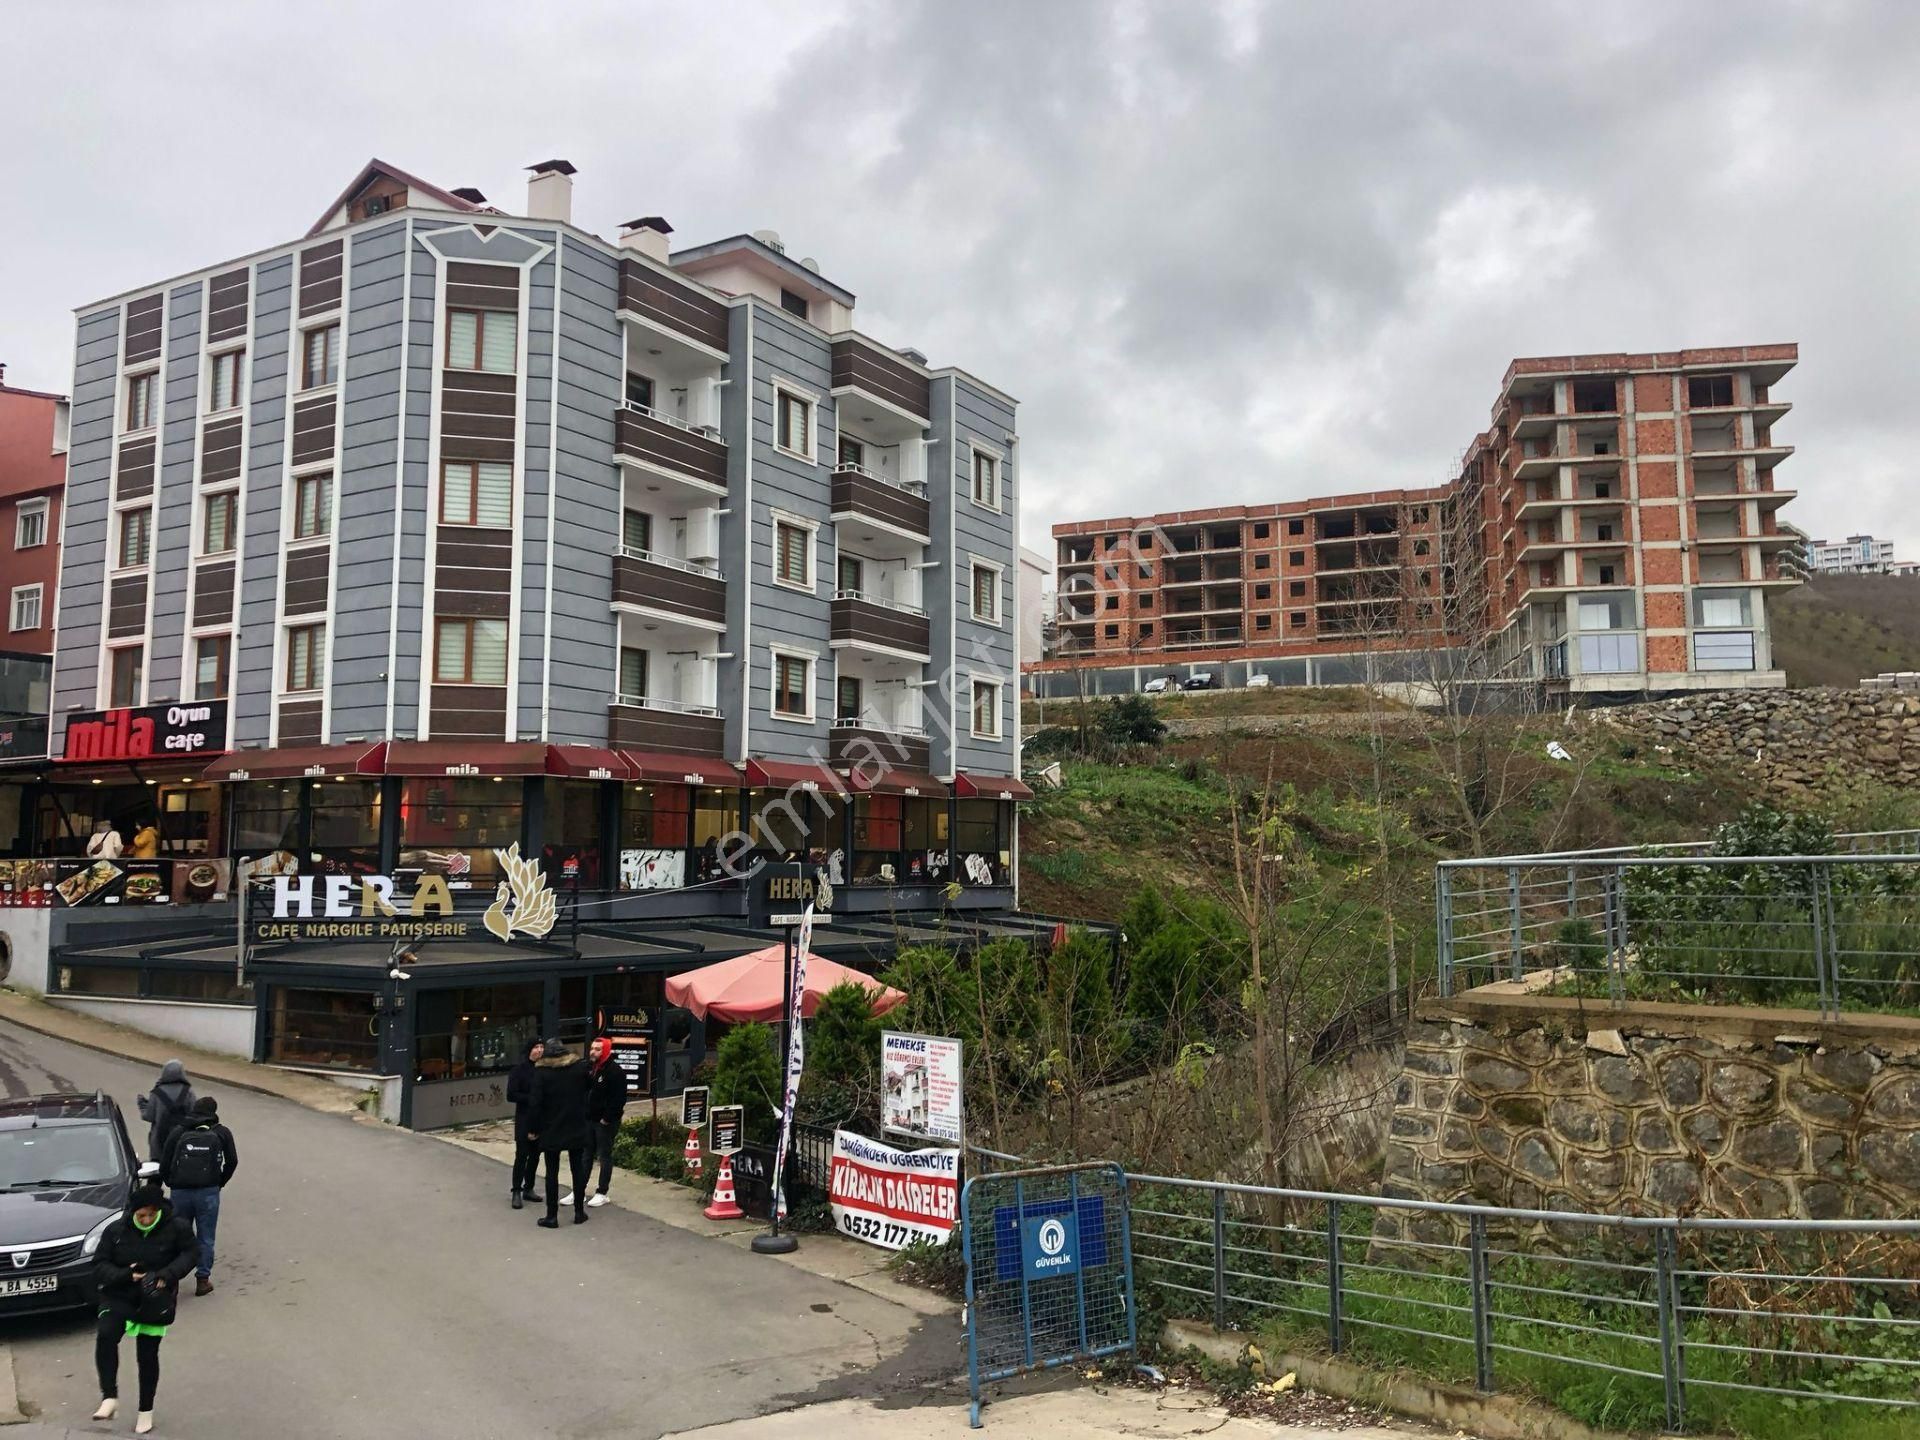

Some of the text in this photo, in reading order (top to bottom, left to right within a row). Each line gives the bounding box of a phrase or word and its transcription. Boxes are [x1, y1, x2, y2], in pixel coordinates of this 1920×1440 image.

[167, 707, 210, 727] Oyun
[67, 709, 156, 759] mila
[165, 732, 204, 751] cafe
[229, 769, 249, 780] mila
[304, 765, 326, 776] mila
[446, 764, 480, 775] mila
[589, 767, 612, 778] mila
[684, 772, 704, 784] mila
[272, 875, 454, 918] HERA
[769, 878, 814, 899] HERA
[258, 922, 467, 938] CAFE NARGILE PATISSERIE
[450, 1093, 485, 1107] HERA
[886, 1174, 956, 1221] DAİRELER
[843, 1213, 881, 1239] 0532
[884, 1223, 908, 1245] 177
[1035, 1253, 1071, 1269] GÜVENLİK
[7, 1280, 21, 1292] BA
[27, 1277, 55, 1290] 4554
